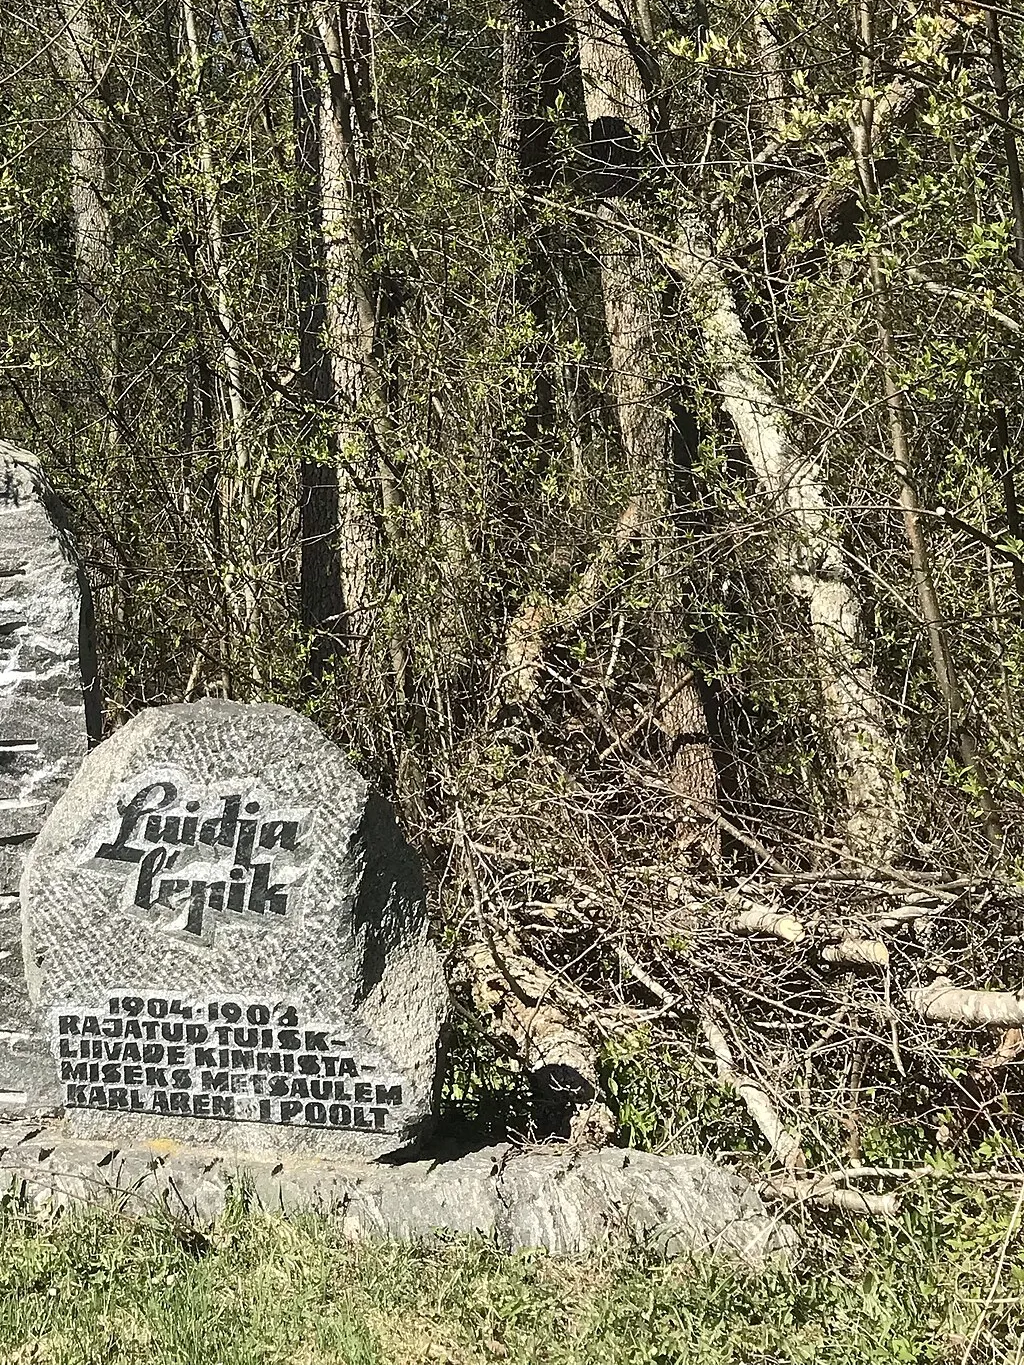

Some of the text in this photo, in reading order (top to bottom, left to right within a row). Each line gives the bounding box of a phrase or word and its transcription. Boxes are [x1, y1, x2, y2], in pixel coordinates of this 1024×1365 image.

[94, 781, 301, 872] Luidja
[59, 1015, 346, 1051] RAJATUD TUISK-
[60, 1038, 376, 1078] LIIVADE KINNISTA-
[61, 1060, 192, 1089] MISEKS
[67, 1083, 145, 1110] KARL
[280, 1100, 390, 1128] POOLT
